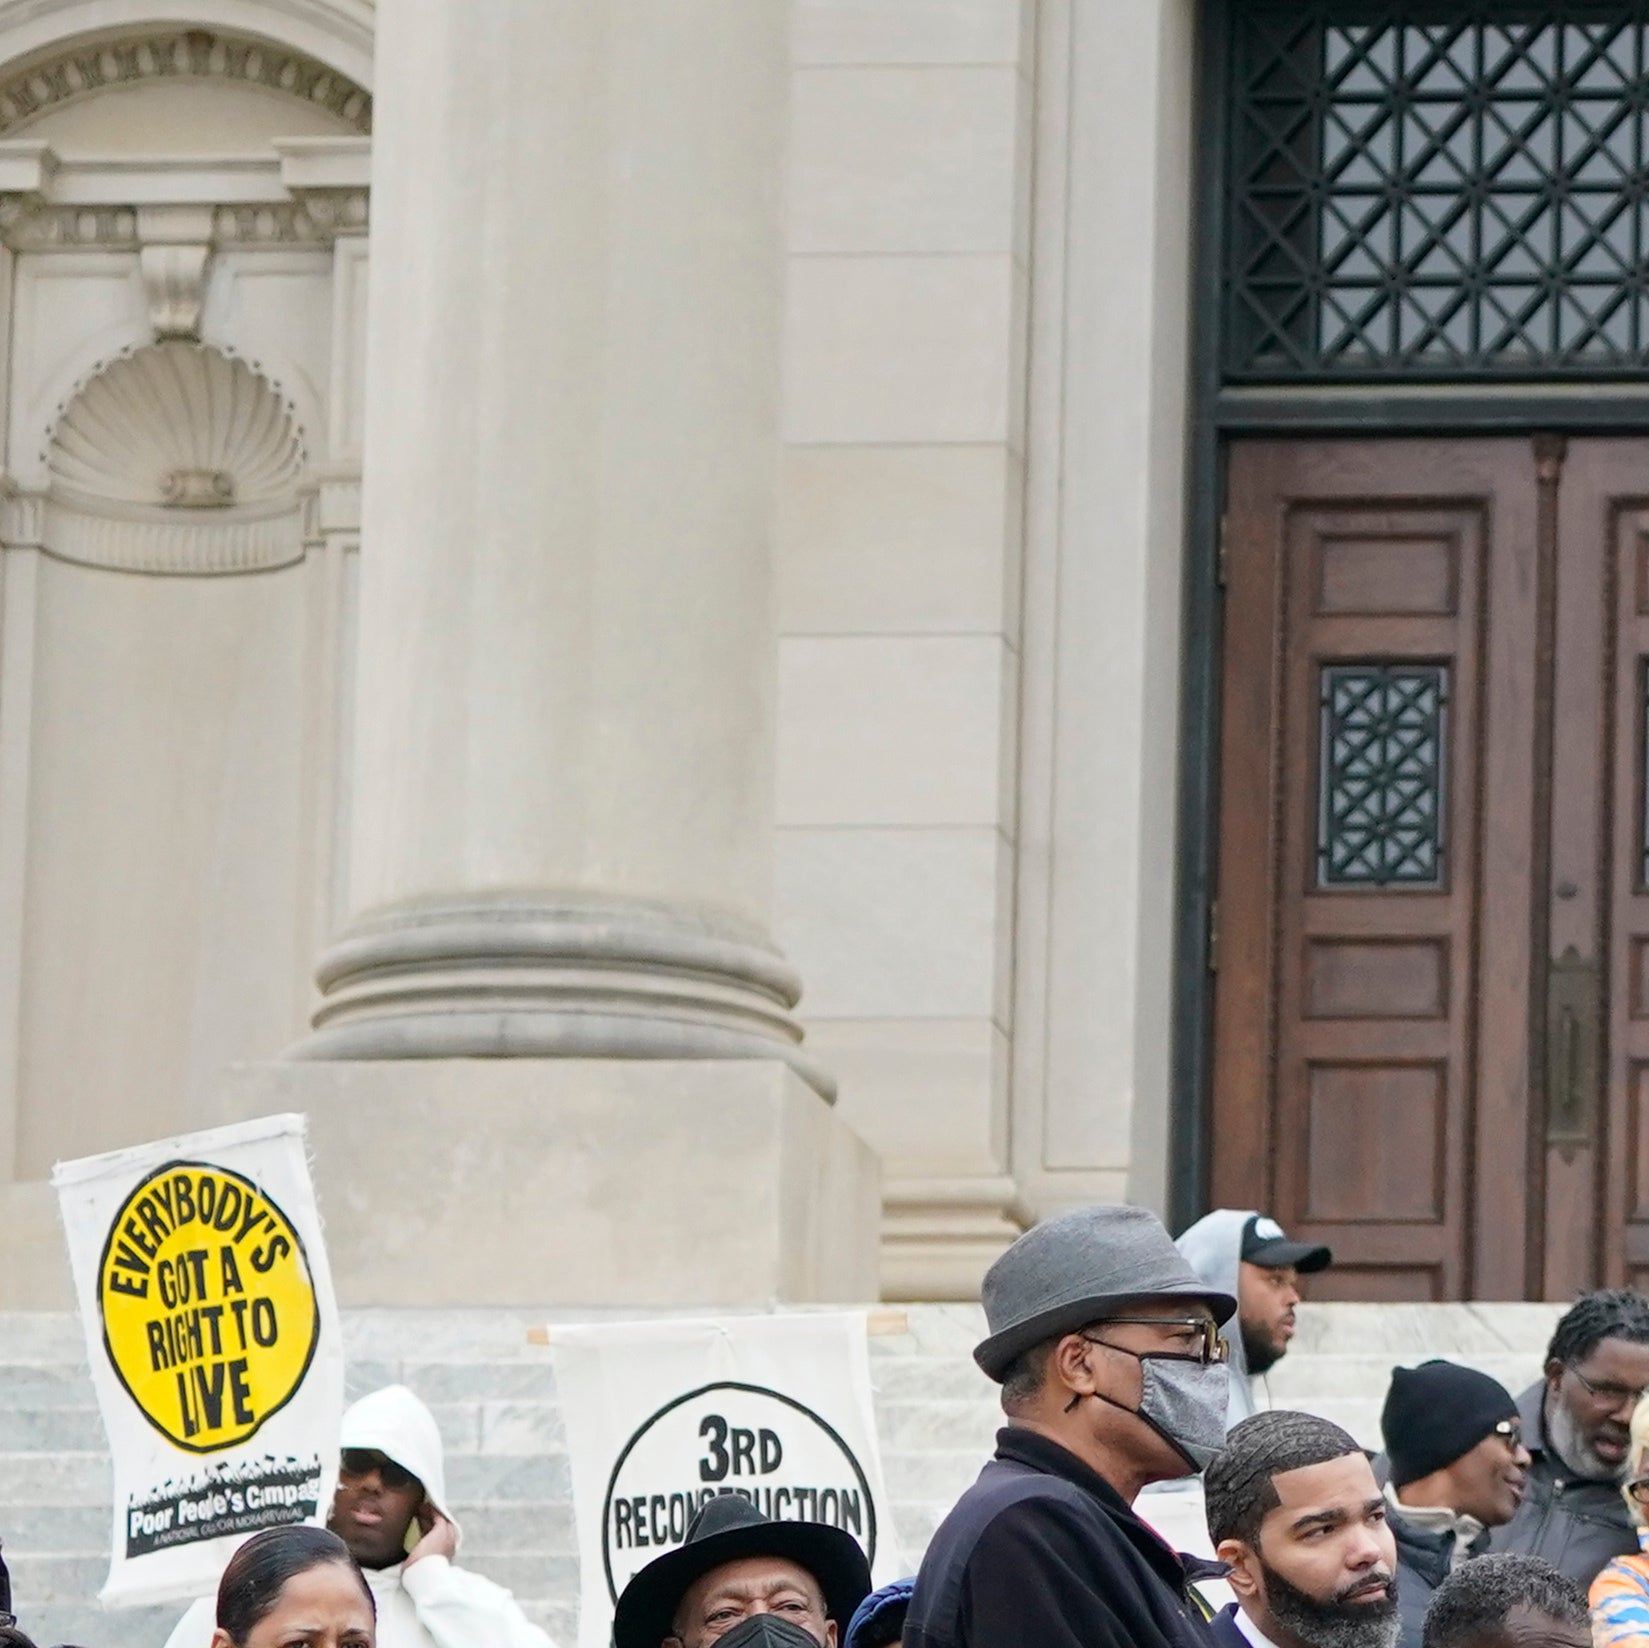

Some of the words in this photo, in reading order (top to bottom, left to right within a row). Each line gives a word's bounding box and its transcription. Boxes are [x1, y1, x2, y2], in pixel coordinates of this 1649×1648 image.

[110, 1175, 290, 1299] EVERYBODY'S
[157, 1247, 208, 1310] GOT
[220, 1246, 243, 1297] A
[147, 1304, 223, 1371] RIGHT
[231, 1297, 278, 1350] TO
[176, 1357, 254, 1438] LIVE
[698, 1414, 782, 1482] 3RD
[130, 1507, 174, 1538] Poor
[614, 1487, 862, 1549] RECONUCTION
